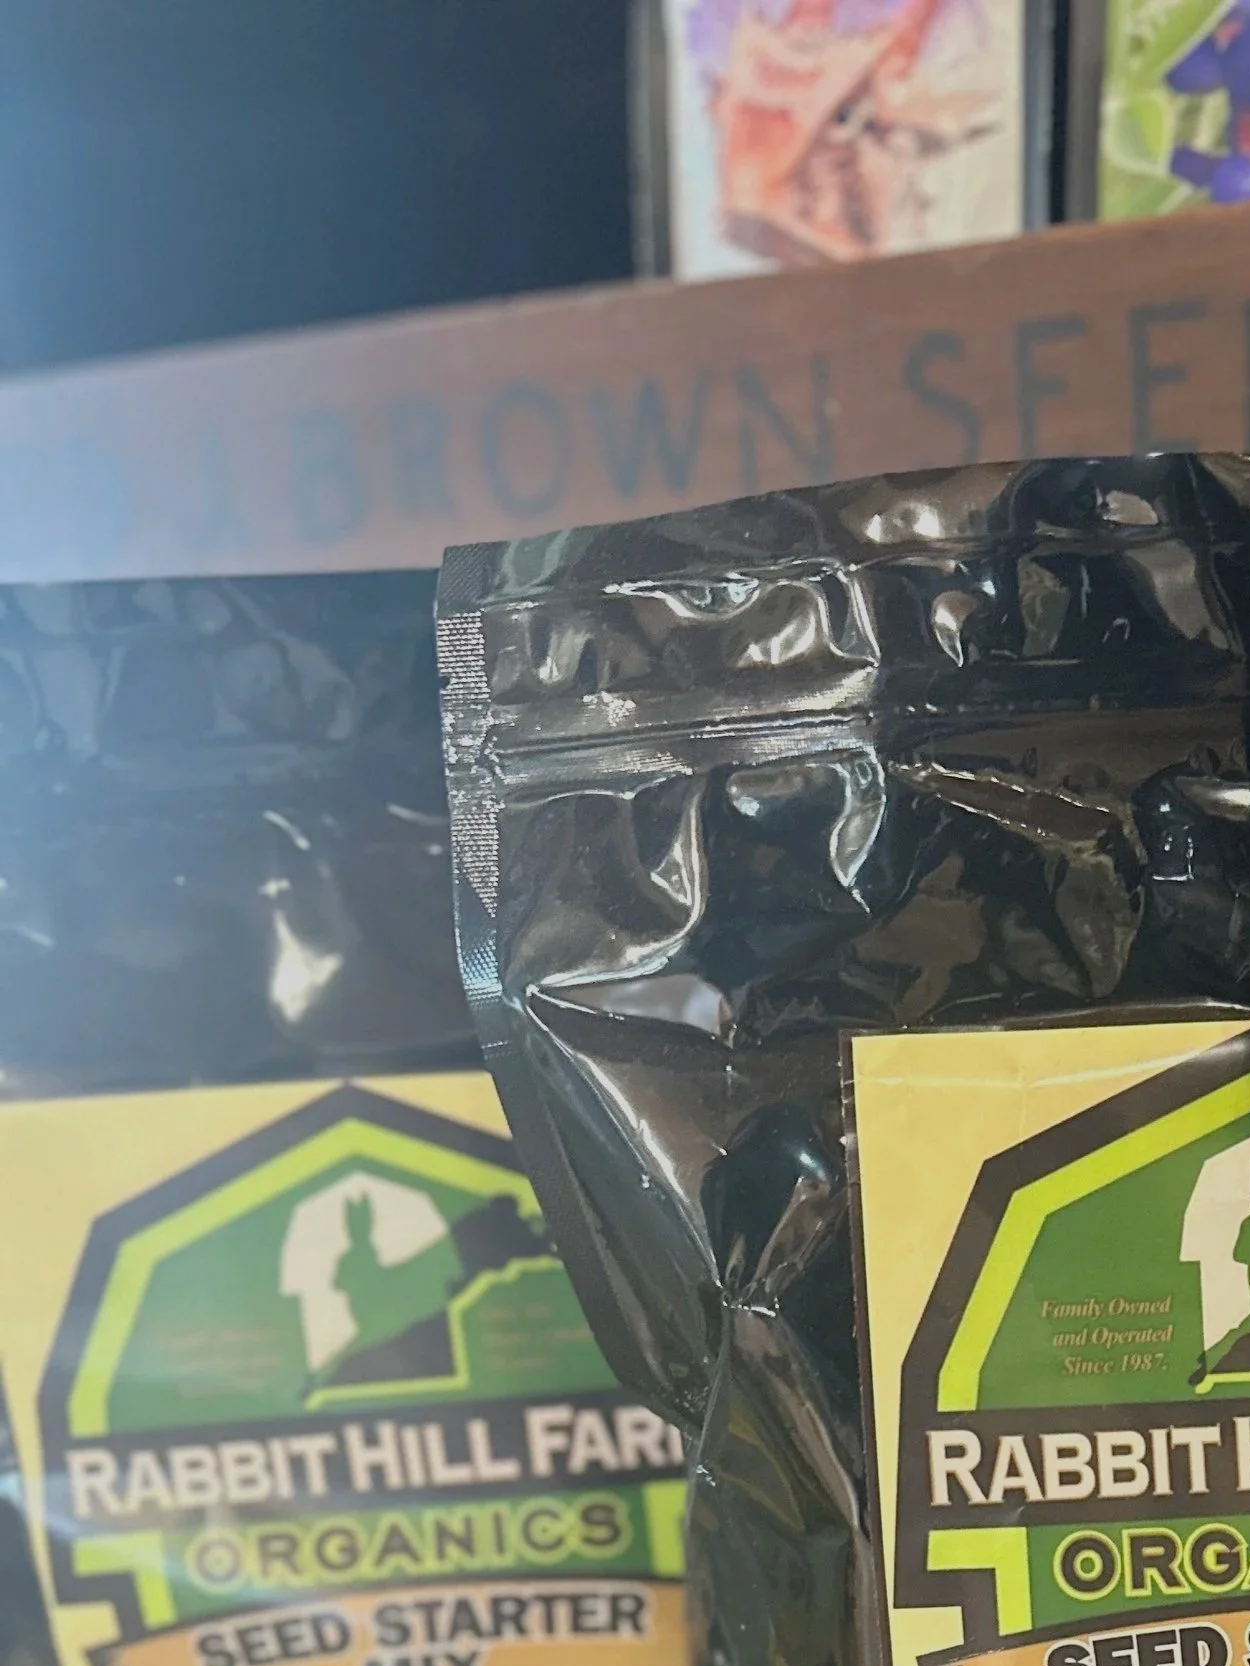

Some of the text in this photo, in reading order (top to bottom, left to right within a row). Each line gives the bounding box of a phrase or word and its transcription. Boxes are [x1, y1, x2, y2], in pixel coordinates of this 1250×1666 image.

[289, 355, 838, 547] BROWN
[1040, 1296, 1172, 1319] Family Owned
[1053, 1324, 1173, 1349] and Operated
[1063, 1352, 1168, 1375] Since 1987.
[65, 1433, 335, 1517] RABBIT
[343, 1419, 520, 1493] HILL
[927, 1424, 1220, 1506] RABBIT
[185, 1495, 632, 1594] ORGANICS
[371, 1590, 648, 1650] STARTER
